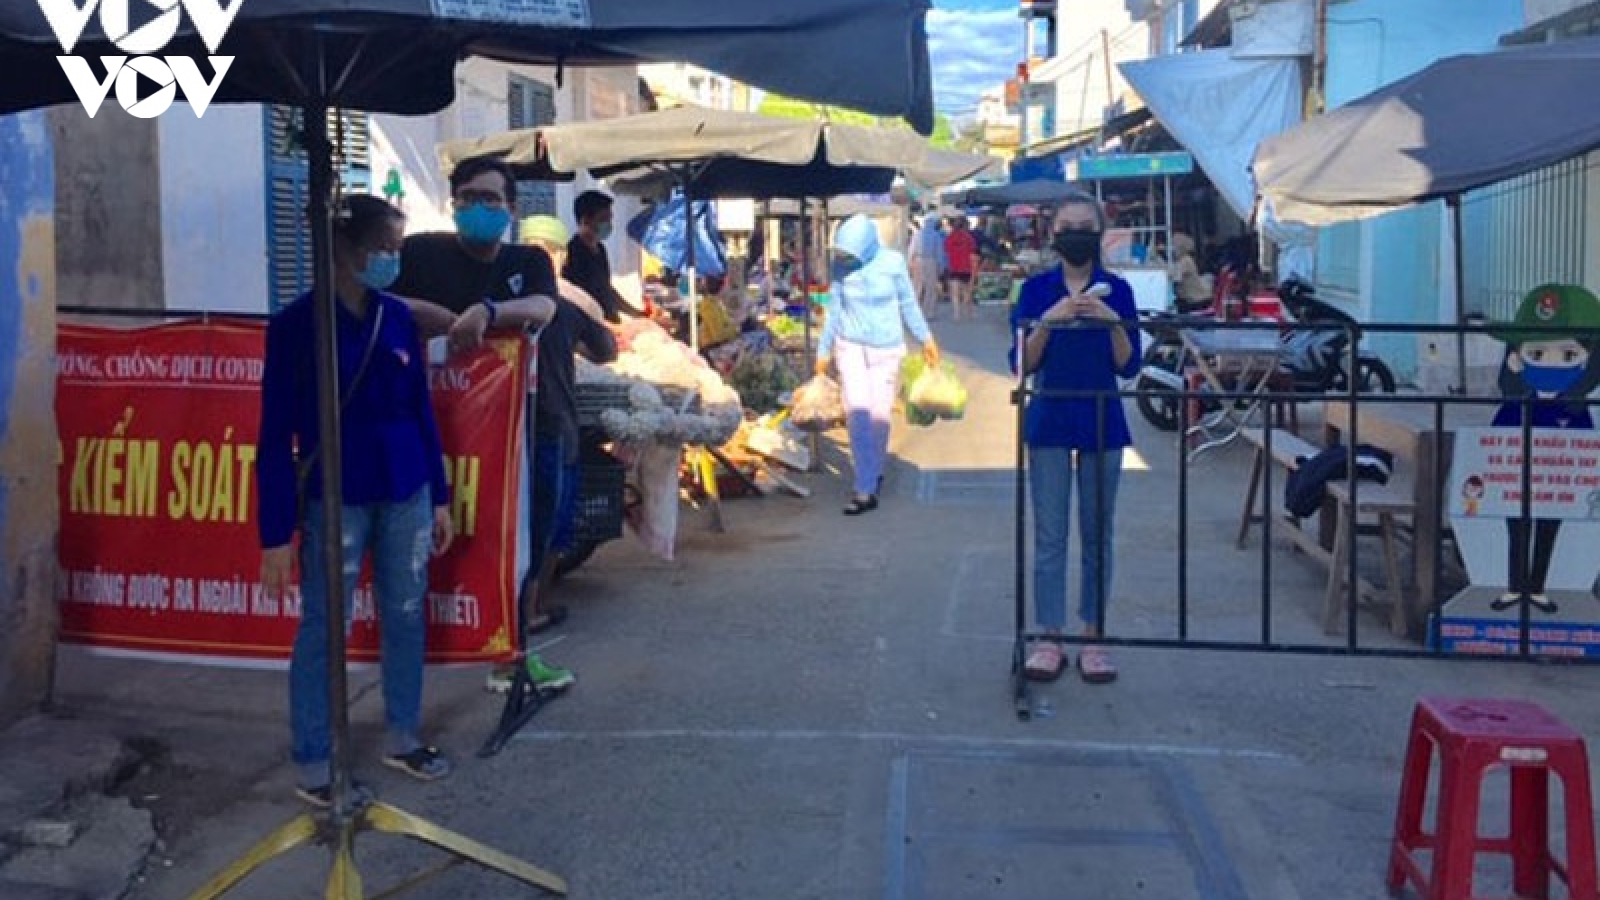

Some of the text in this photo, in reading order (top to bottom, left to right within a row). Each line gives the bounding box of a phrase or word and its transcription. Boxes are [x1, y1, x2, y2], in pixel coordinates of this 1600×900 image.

[104, 345, 168, 379] CHỐNG
[170, 353, 213, 385] DỊCH
[69, 405, 160, 517] KIỂM
[168, 425, 257, 523] SOÁT
[173, 577, 195, 612] RA
